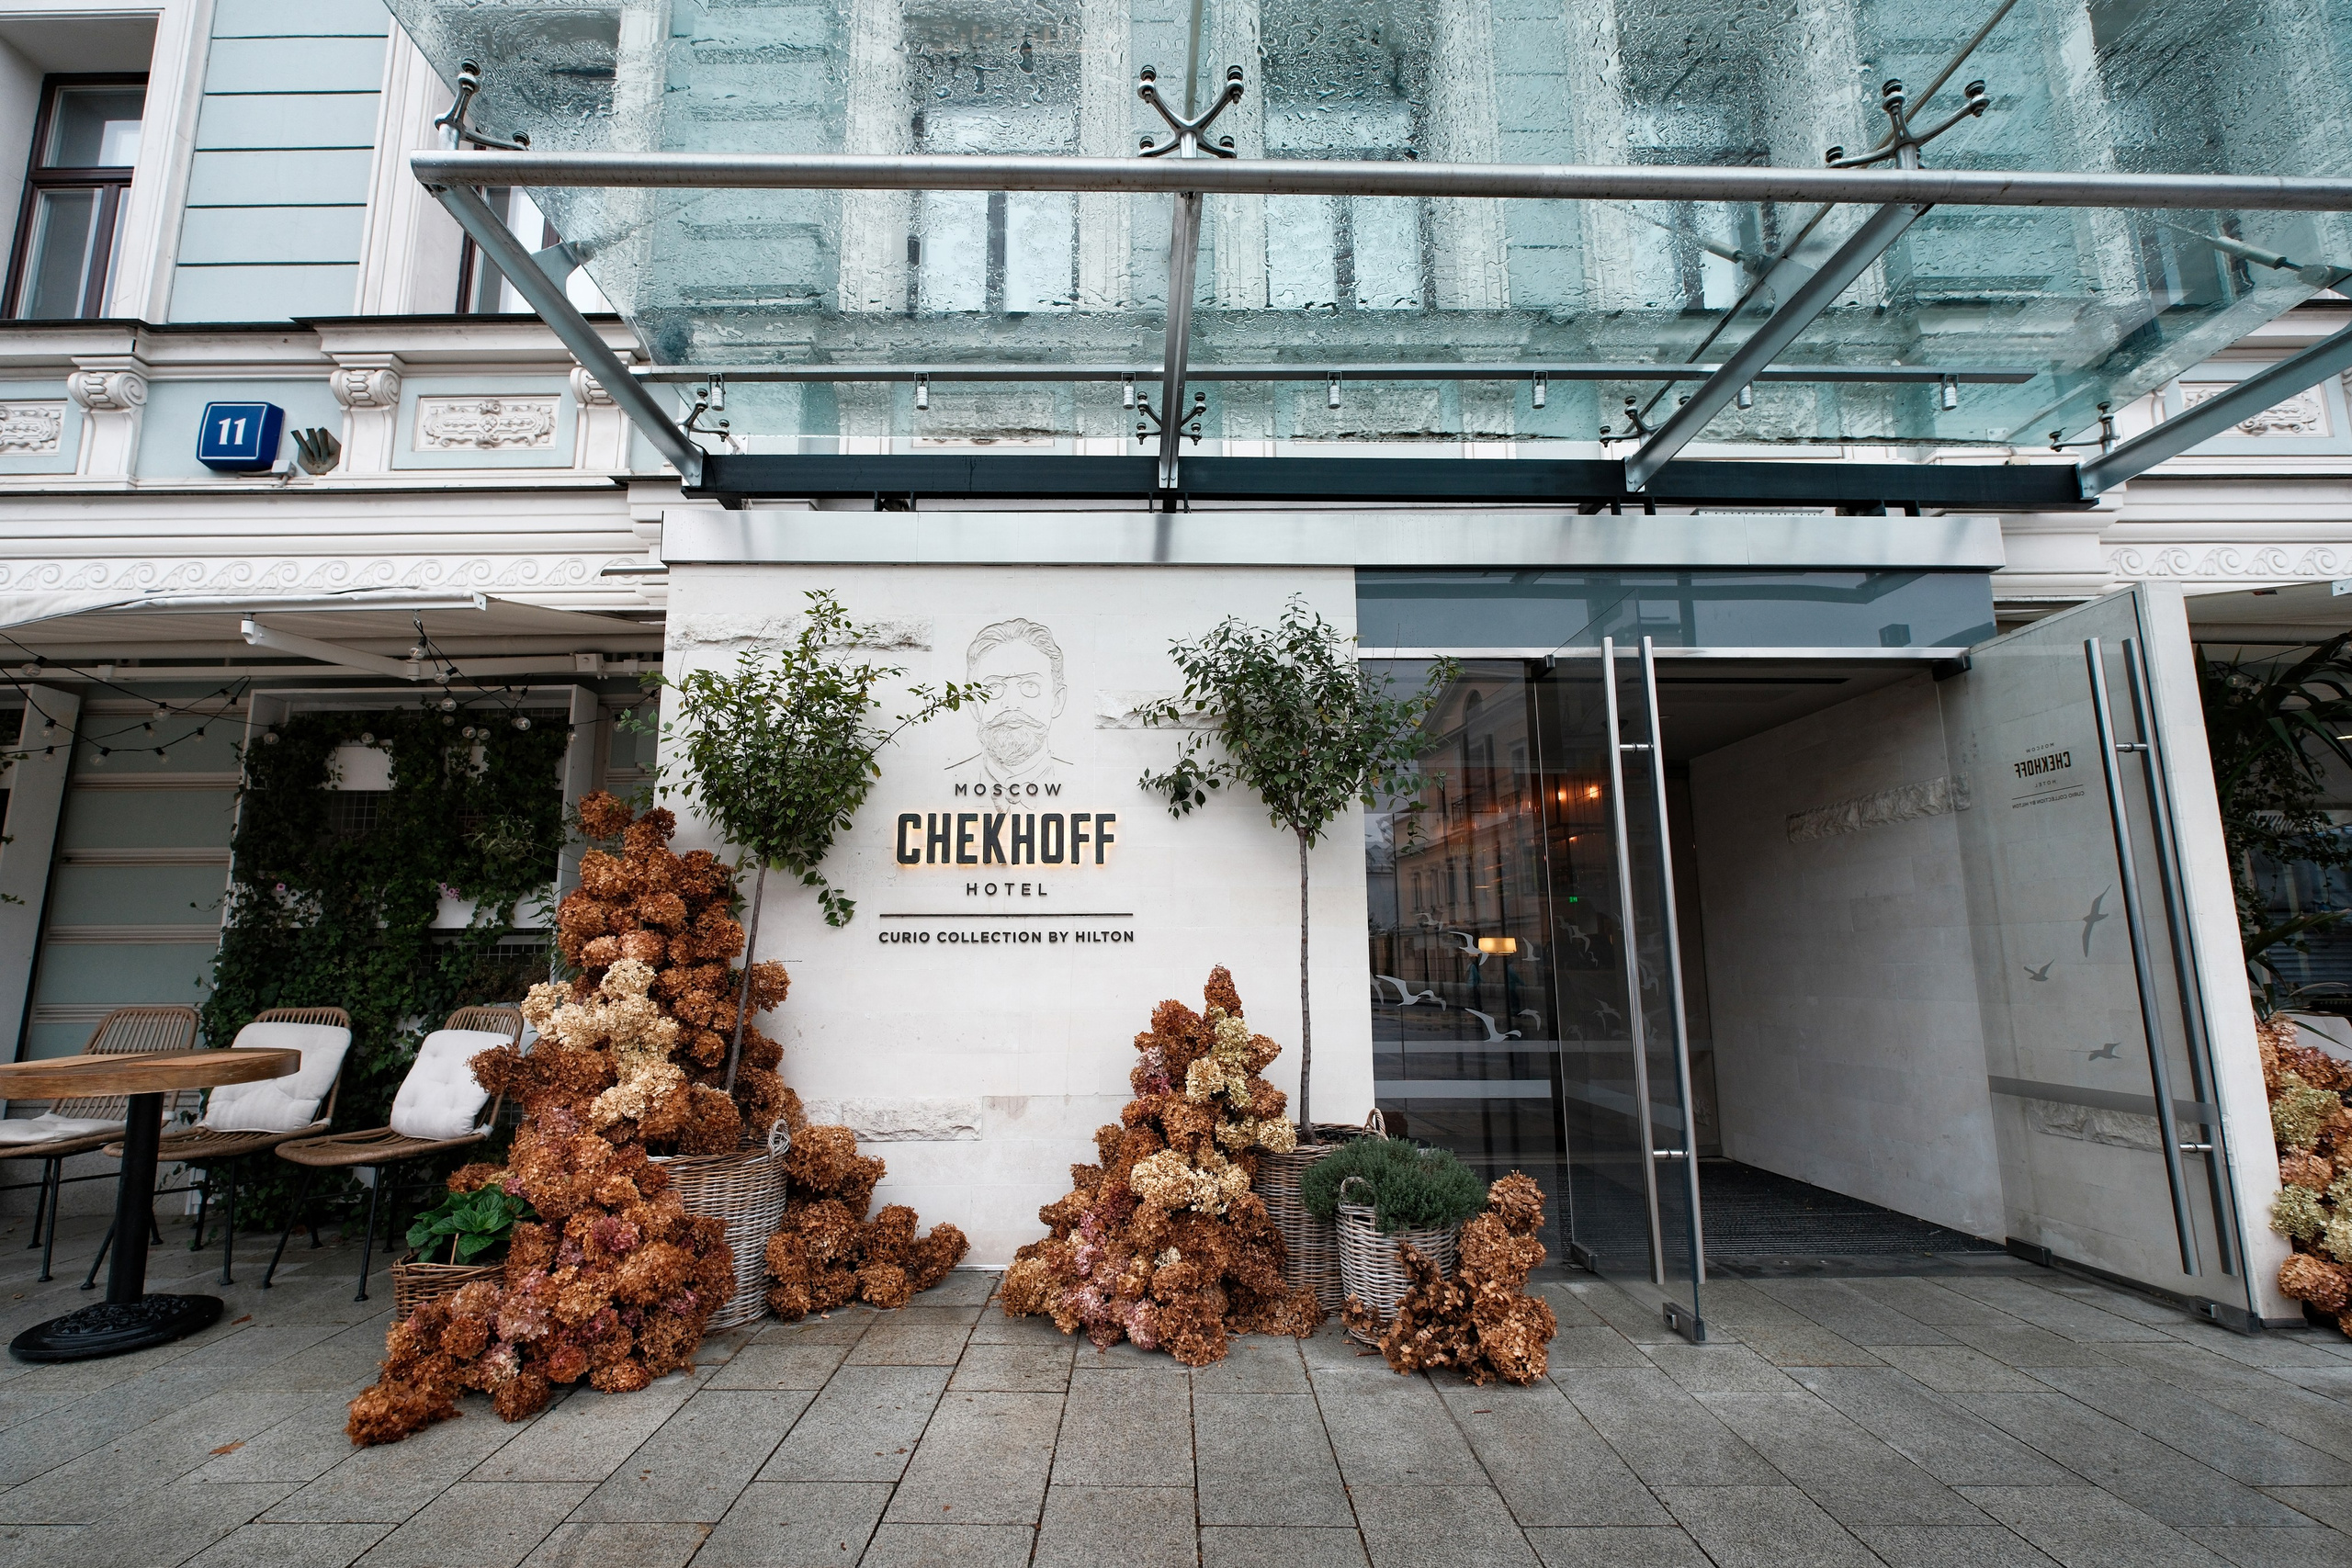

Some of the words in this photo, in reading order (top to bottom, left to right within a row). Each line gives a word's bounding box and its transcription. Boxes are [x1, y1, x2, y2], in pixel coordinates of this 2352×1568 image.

[218, 417, 247, 446] 11
[955, 783, 1062, 796] MOSCOW
[896, 812, 1116, 865] CHEKHOFF
[966, 882, 1047, 897] HOTEL
[878, 931, 931, 943] CURIO
[936, 931, 1042, 943] COLLECTION
[1048, 931, 1069, 943] BY
[1075, 930, 1135, 943] HILTON
